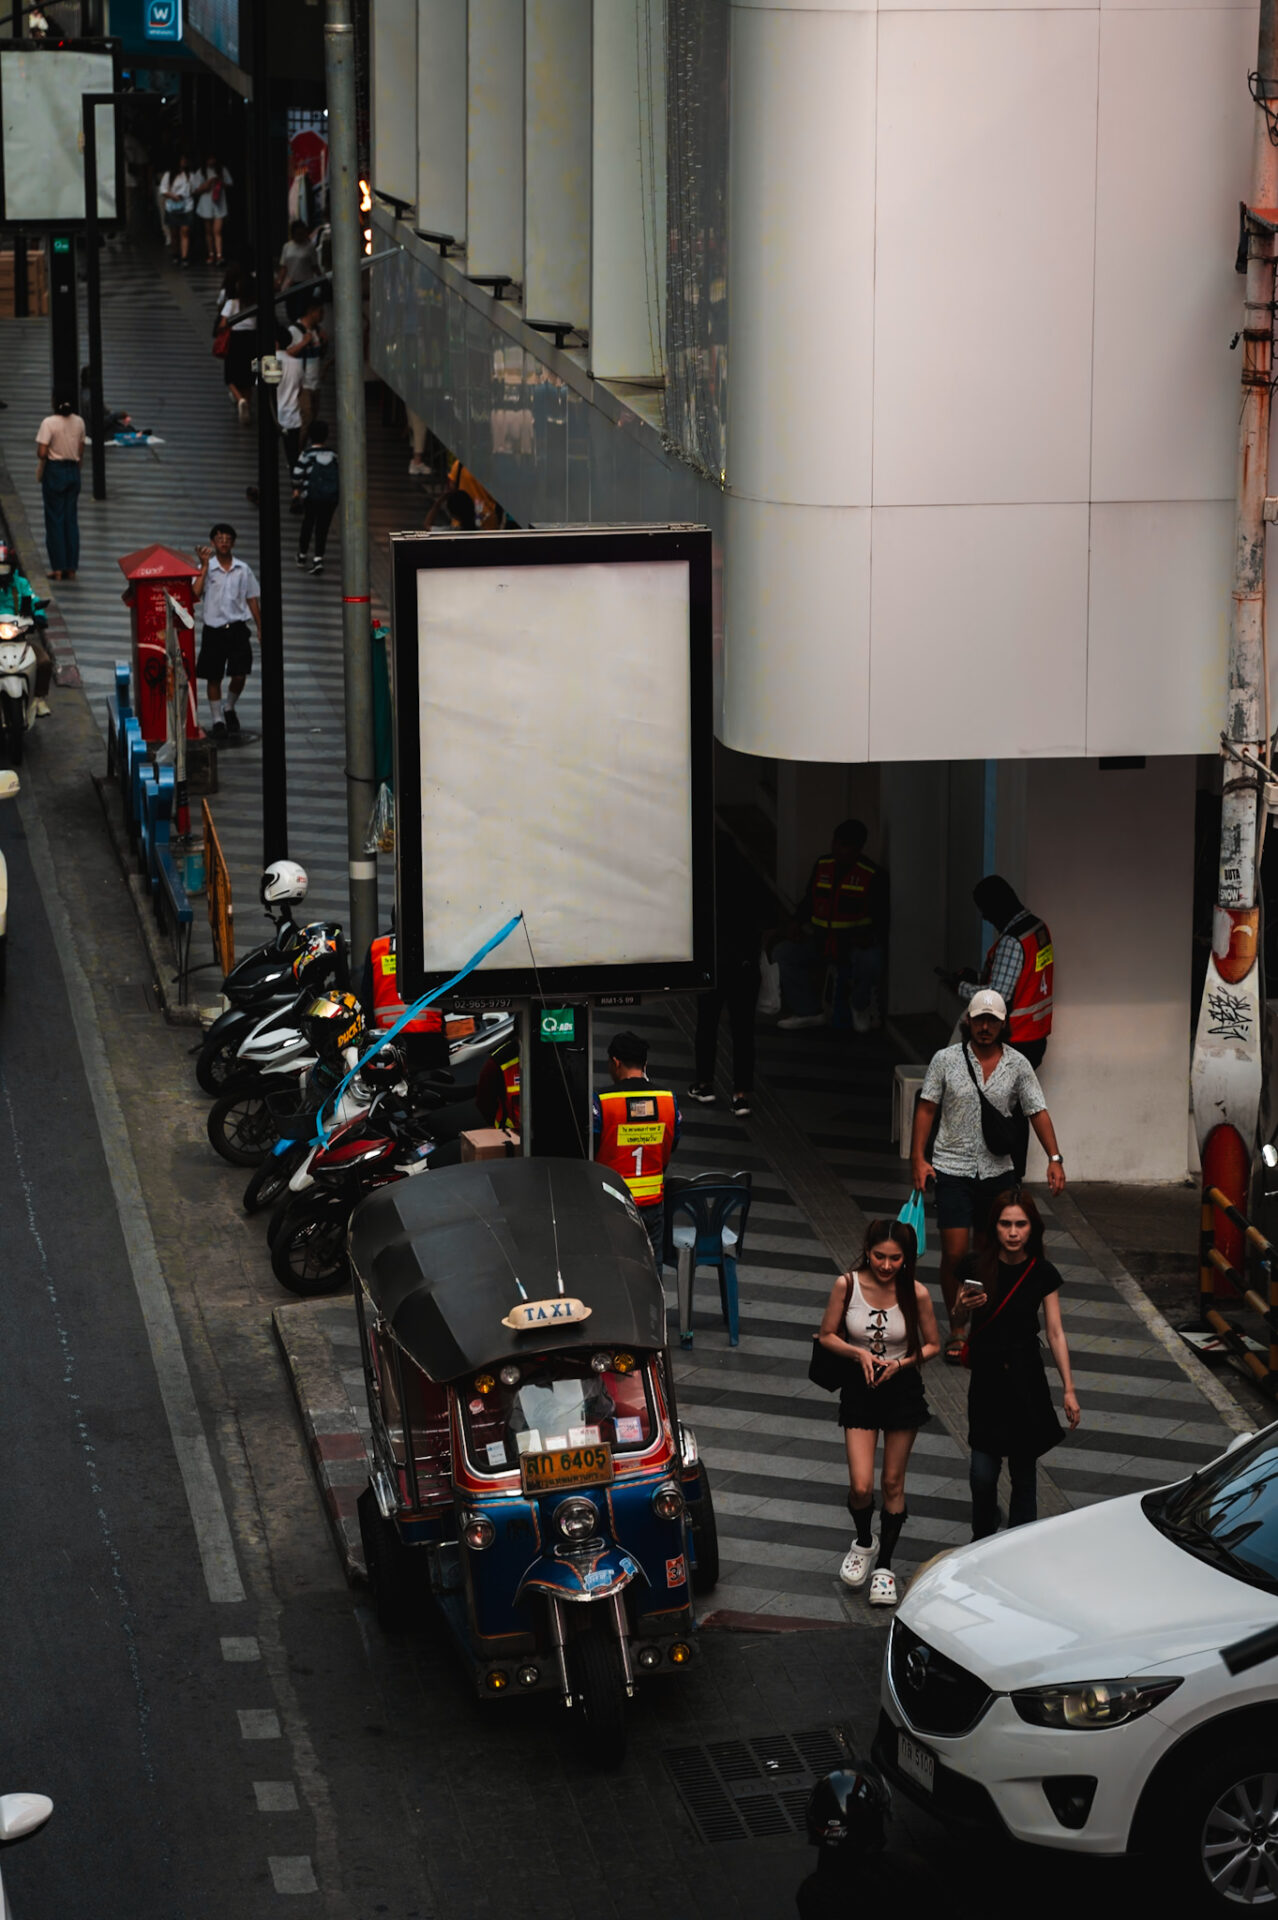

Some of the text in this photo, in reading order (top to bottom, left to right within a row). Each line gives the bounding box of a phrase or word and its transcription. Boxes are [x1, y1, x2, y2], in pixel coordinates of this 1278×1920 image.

[153, 7, 169, 20] W
[1040, 971, 1048, 996] 4
[454, 999, 511, 1009] 02-965-9797
[631, 1146, 643, 1176] 1
[524, 1302, 572, 1321] TAXI
[561, 1448, 606, 1471] 6405
